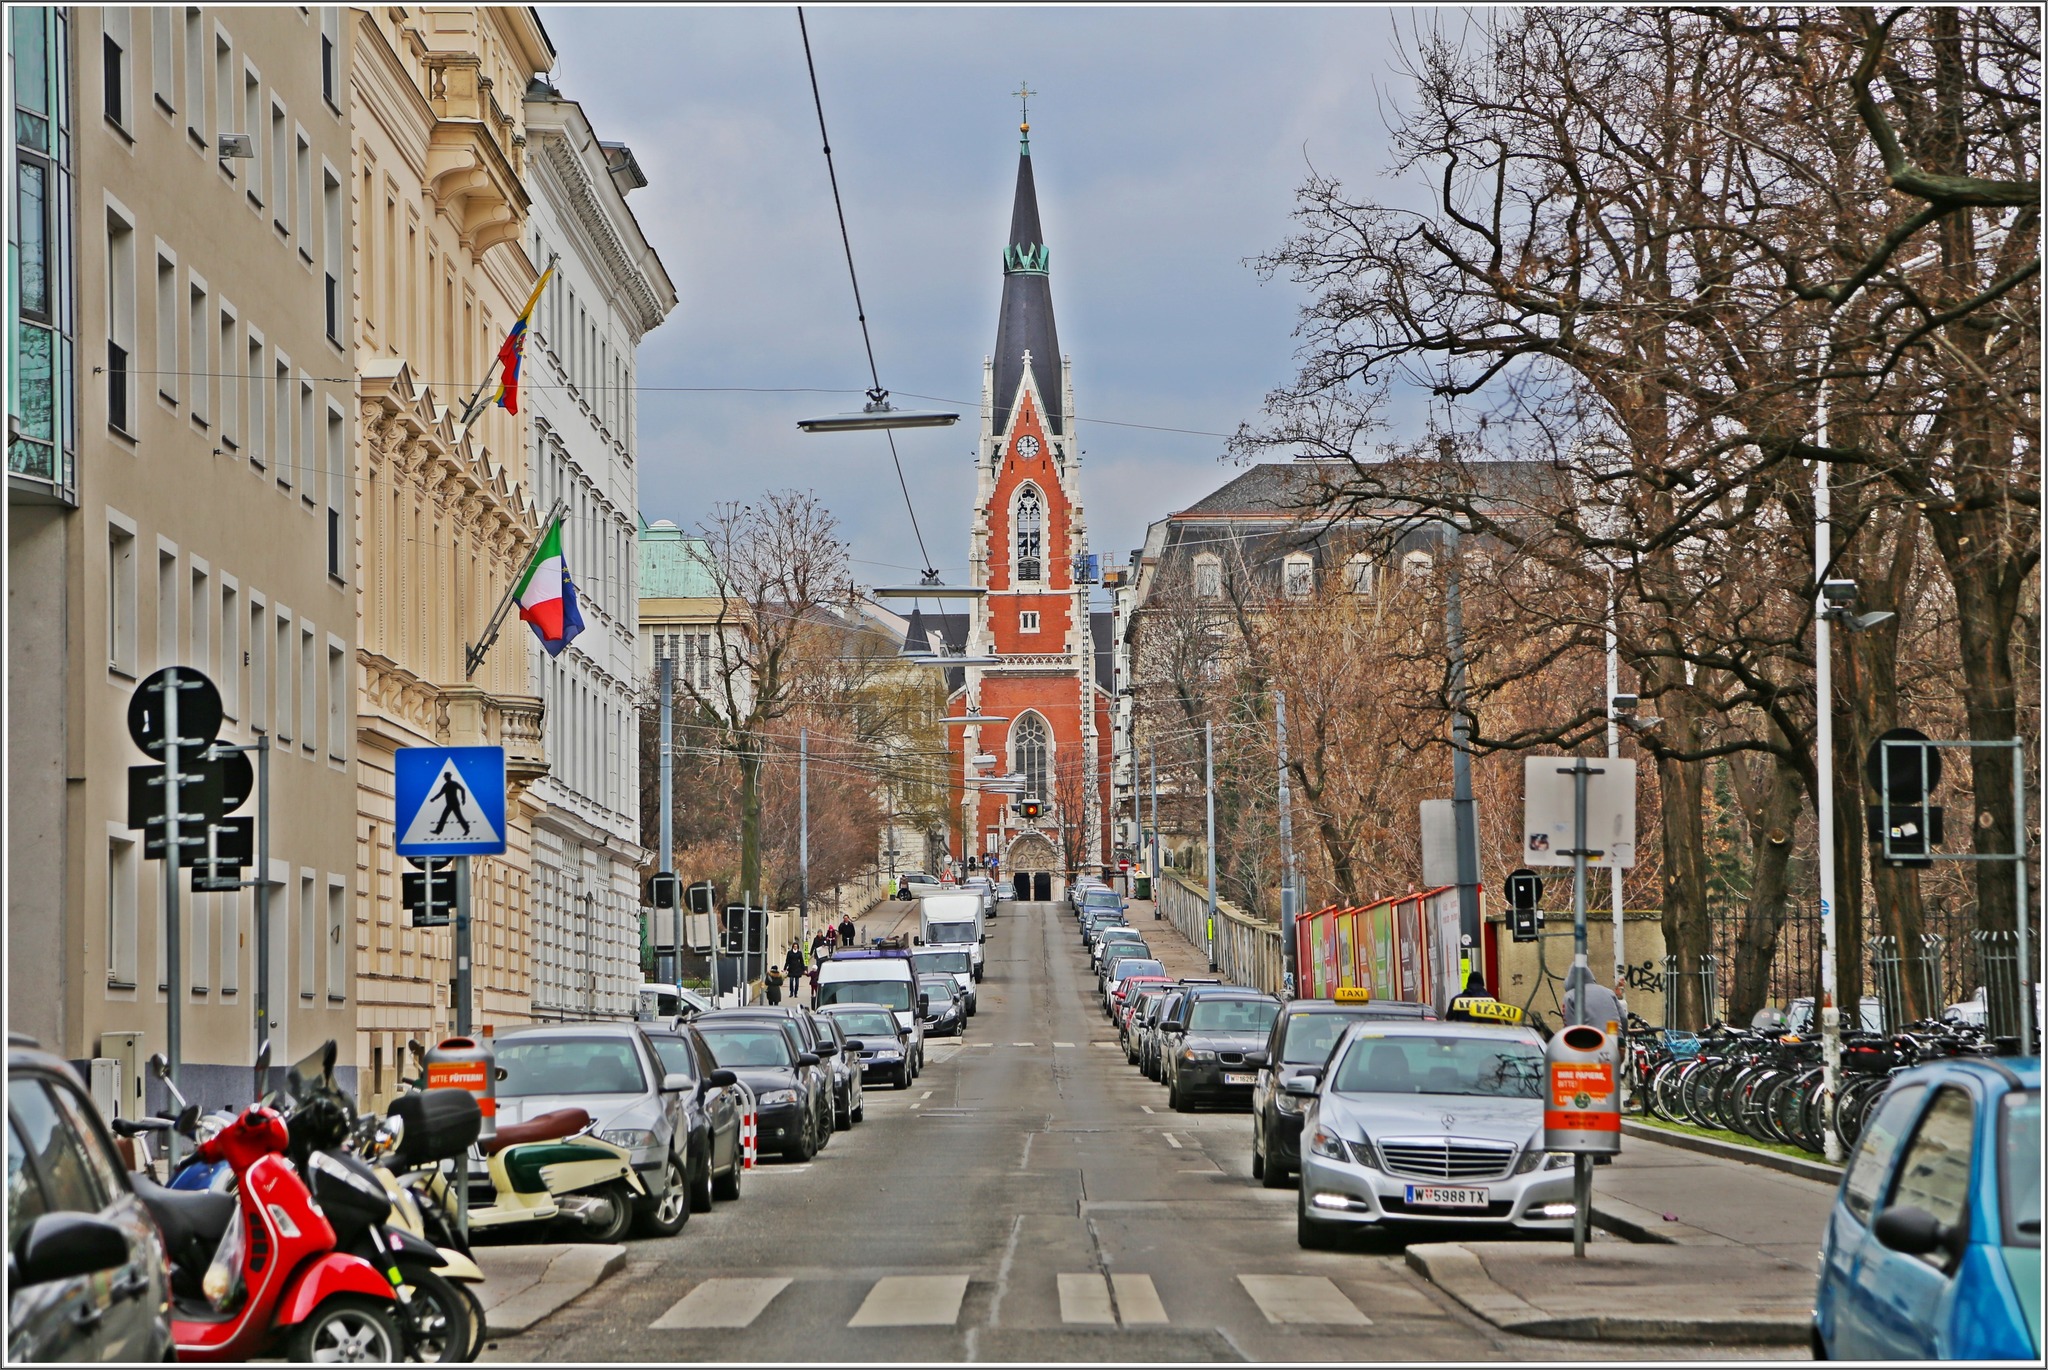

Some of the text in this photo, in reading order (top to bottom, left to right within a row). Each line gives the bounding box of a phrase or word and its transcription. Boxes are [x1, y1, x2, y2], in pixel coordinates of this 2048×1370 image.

[1476, 1003, 1517, 1019] TAXI
[430, 1074, 448, 1083] BITTE
[1415, 1188, 1484, 1204] W 5988 TX
